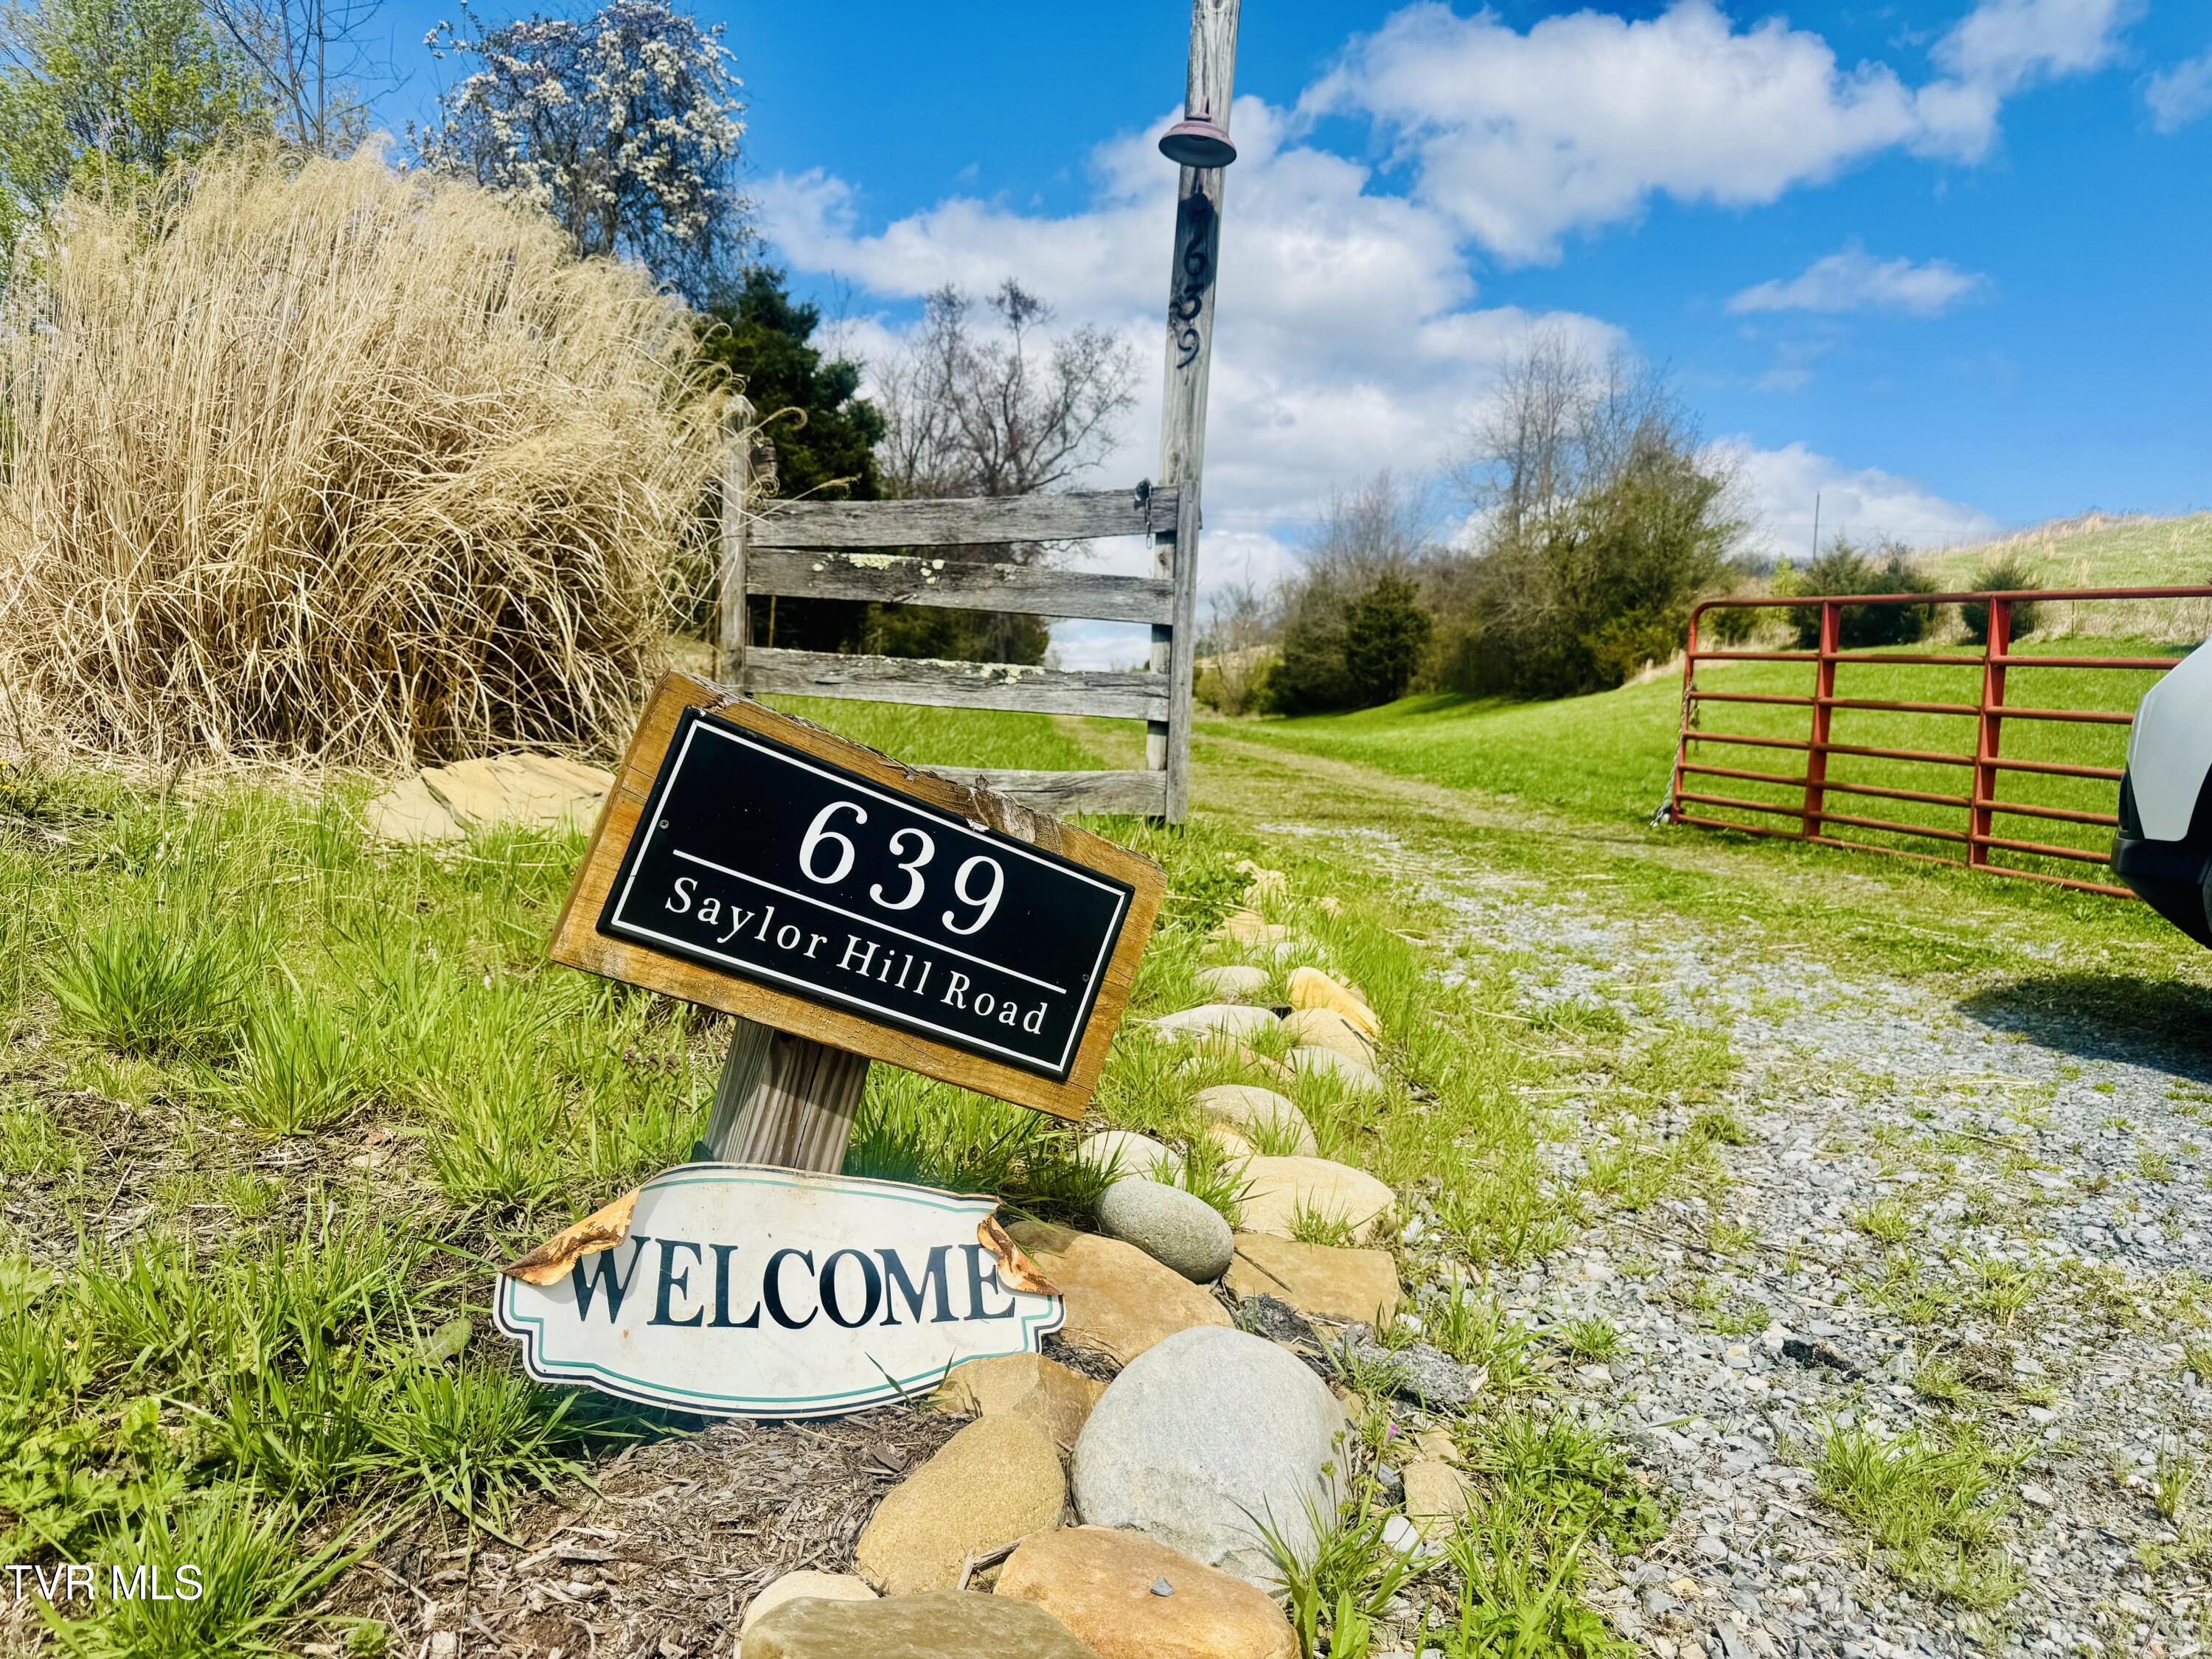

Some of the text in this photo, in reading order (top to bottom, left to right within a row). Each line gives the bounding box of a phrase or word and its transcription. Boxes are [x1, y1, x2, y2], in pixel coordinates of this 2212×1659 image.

[1175, 234, 1207, 369] 639
[799, 801, 1005, 936] 639
[665, 877, 1048, 1035] Saylor Hill Road
[571, 1234, 1015, 1329] WELCOME
